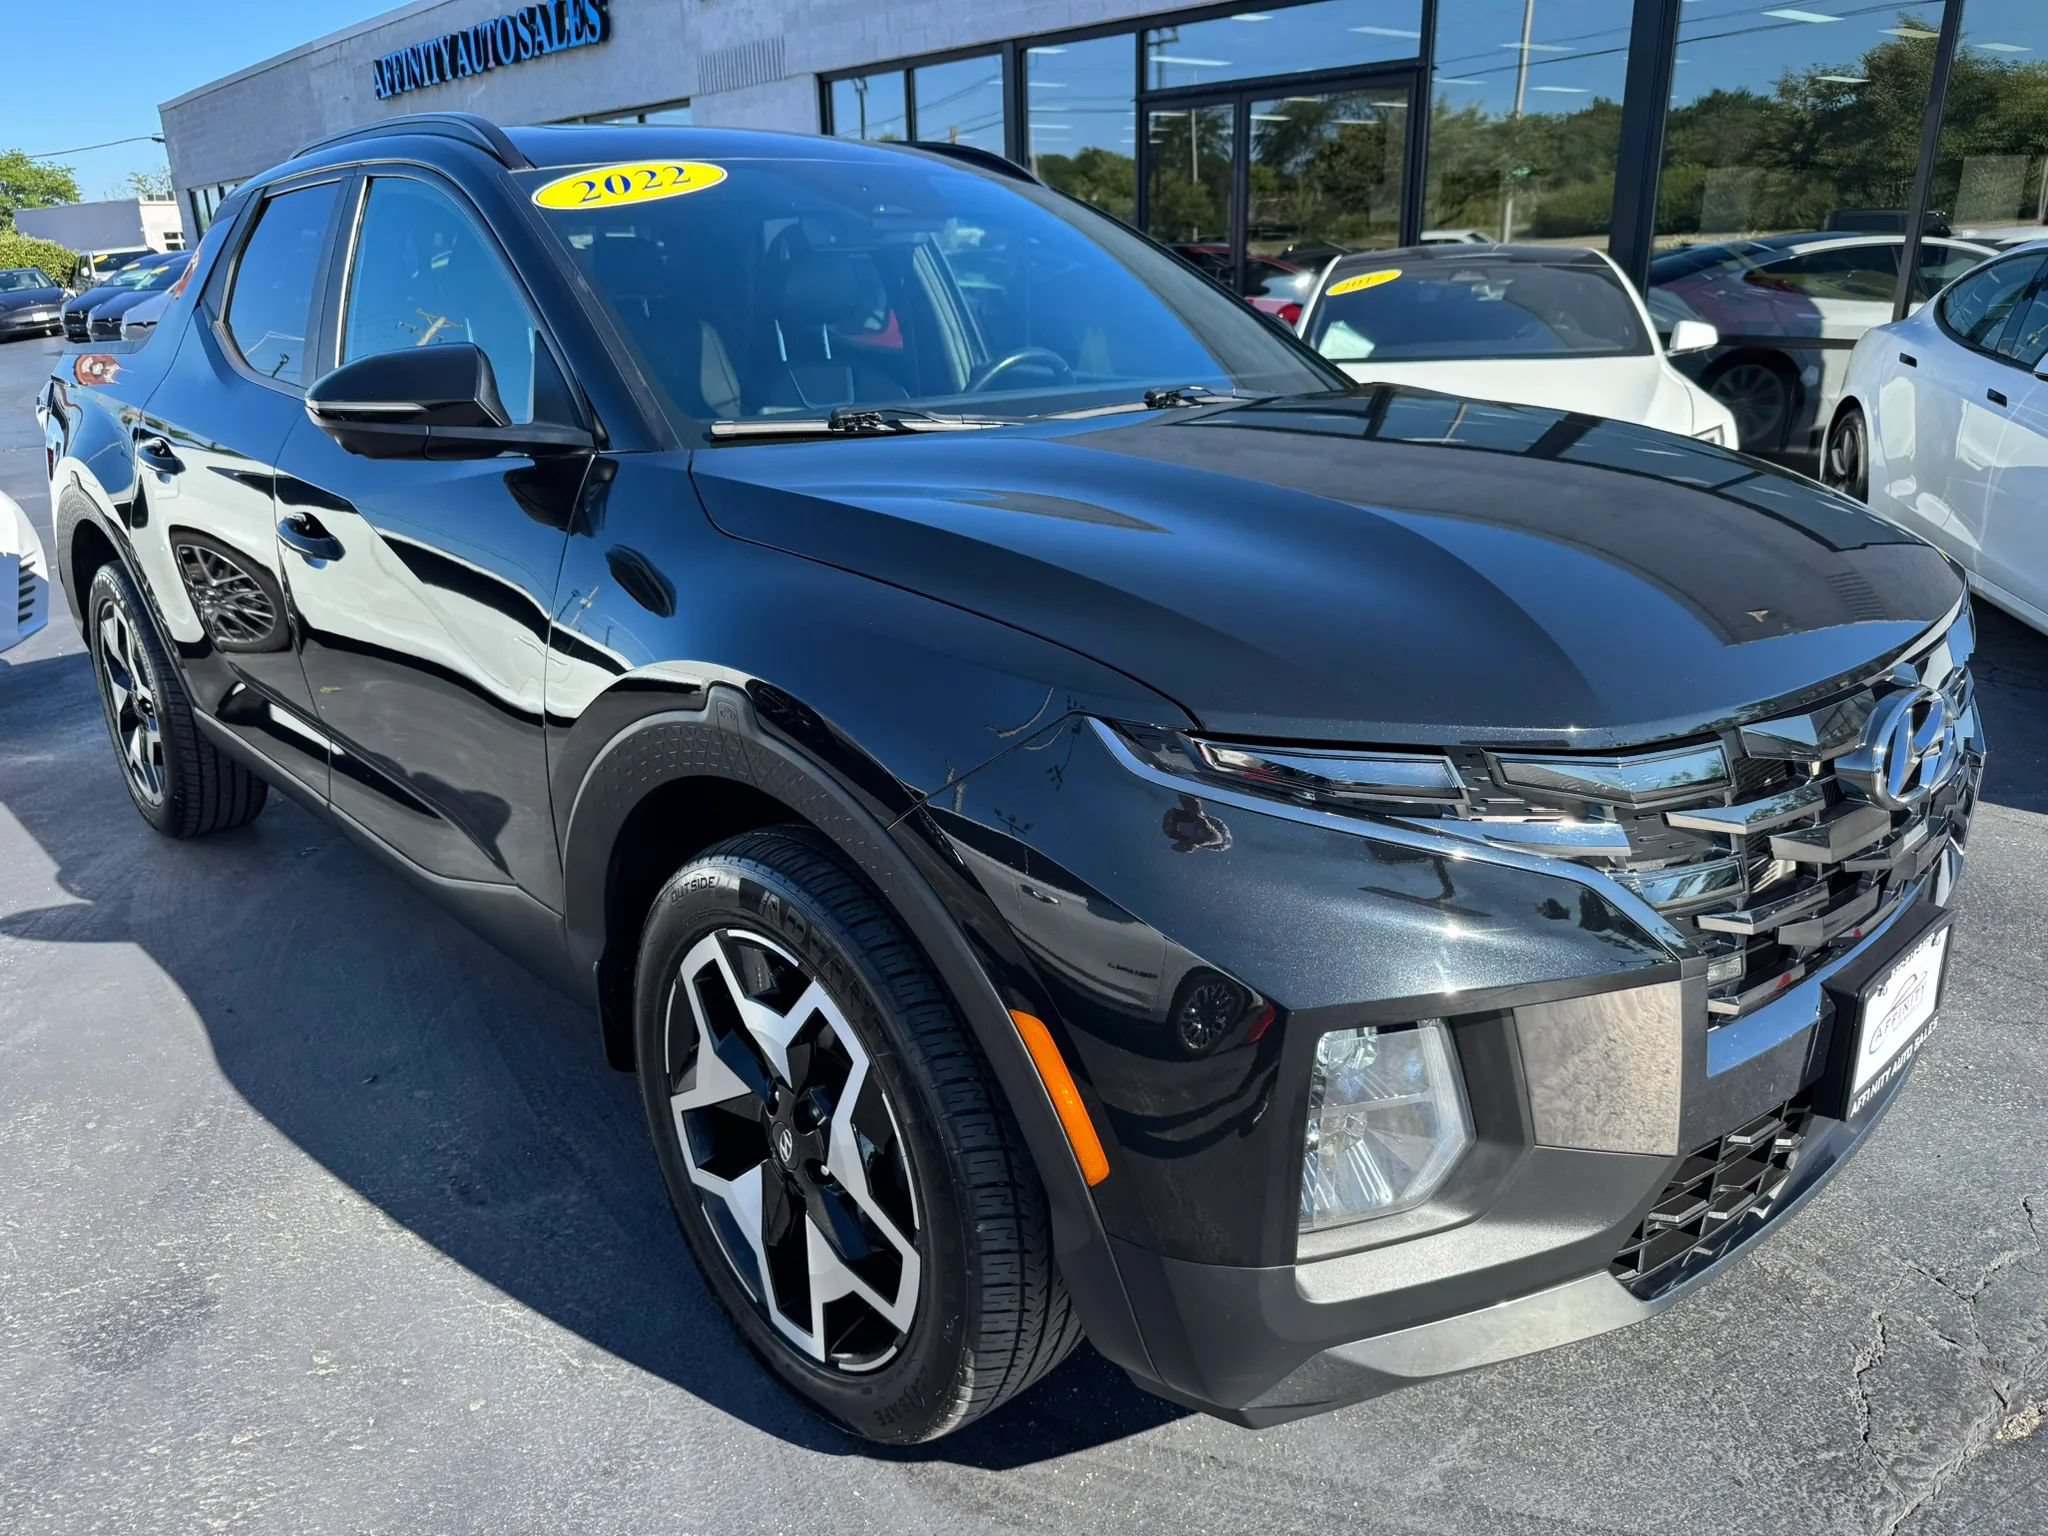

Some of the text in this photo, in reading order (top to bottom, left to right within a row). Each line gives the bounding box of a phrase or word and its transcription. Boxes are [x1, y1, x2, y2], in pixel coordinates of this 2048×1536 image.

[373, 35, 453, 100] AFFINITY
[572, 165, 692, 203] 2022
[671, 875, 716, 905] OUTSIDE
[1874, 980, 1927, 1042] AFFINITY
[1850, 1066, 1891, 1118] AFFINITY
[1890, 1043, 1913, 1077] AUTO
[1914, 1015, 1939, 1052] SALES
